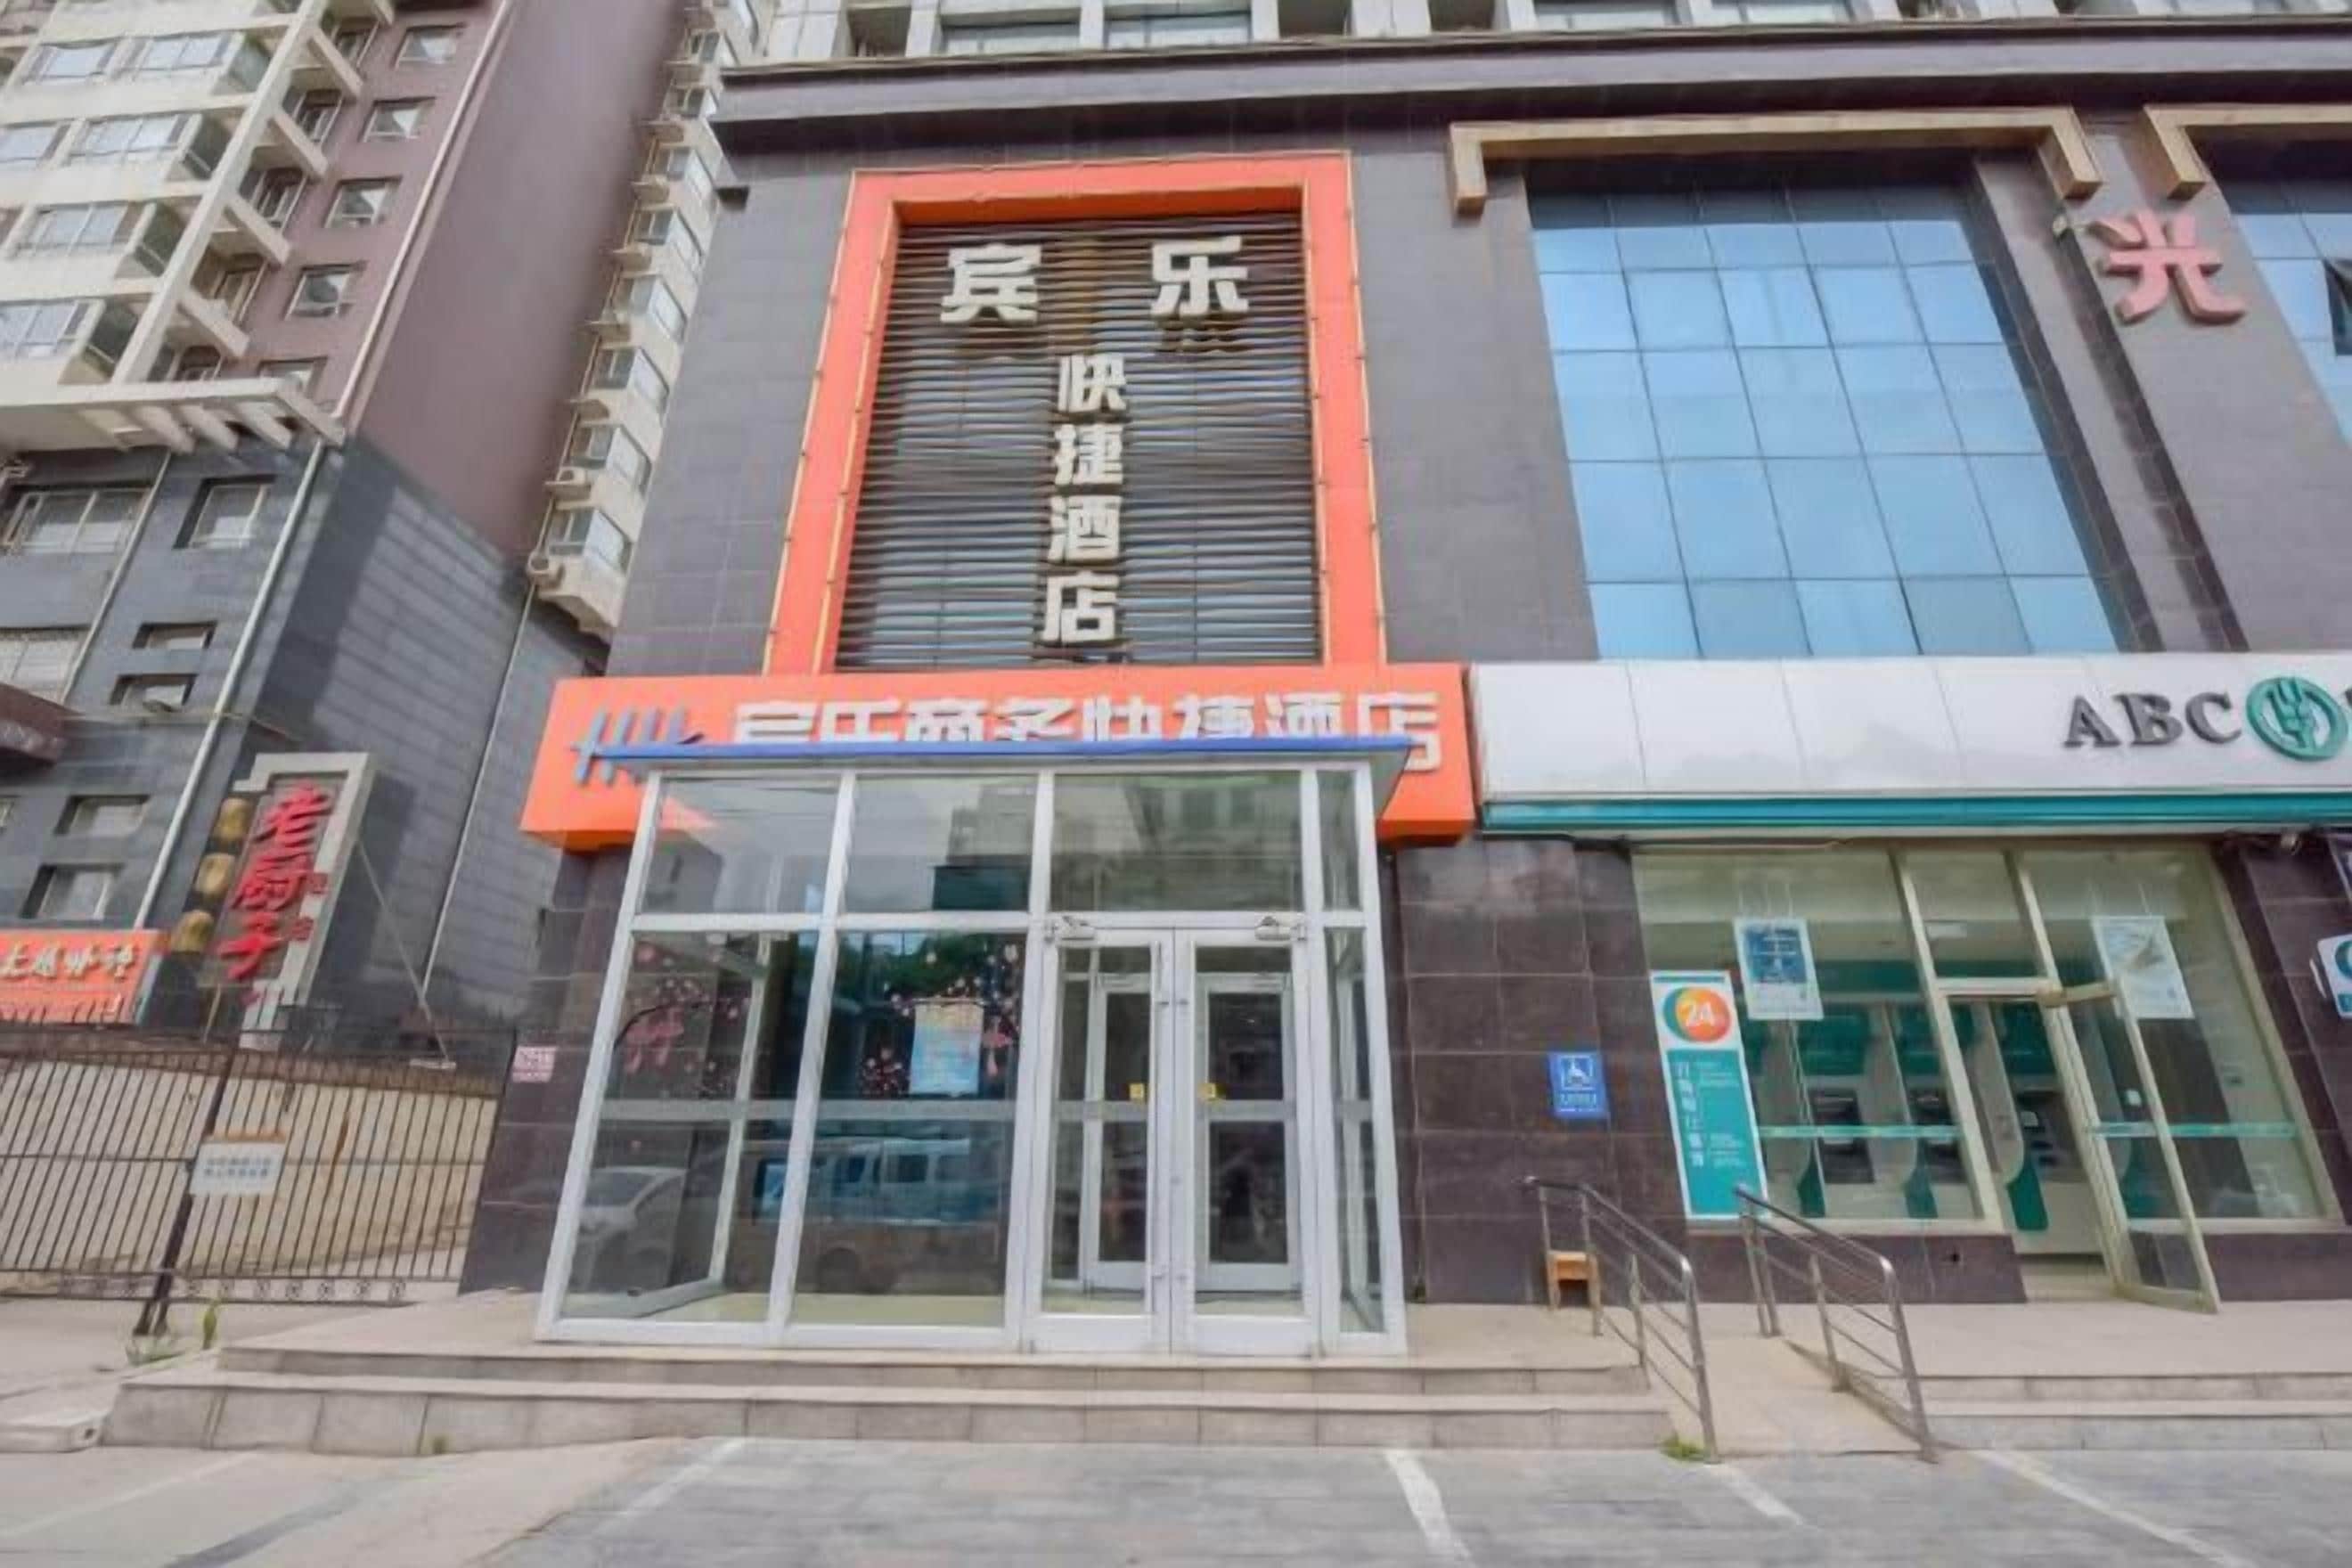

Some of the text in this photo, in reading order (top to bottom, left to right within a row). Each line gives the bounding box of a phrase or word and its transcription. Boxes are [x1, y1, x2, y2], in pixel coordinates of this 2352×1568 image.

[2087, 209, 2247, 324] 光
[1041, 353, 1129, 648] 快捷酒店
[2062, 691, 2242, 749] ABC
[1685, 1001, 1717, 1027] 24
